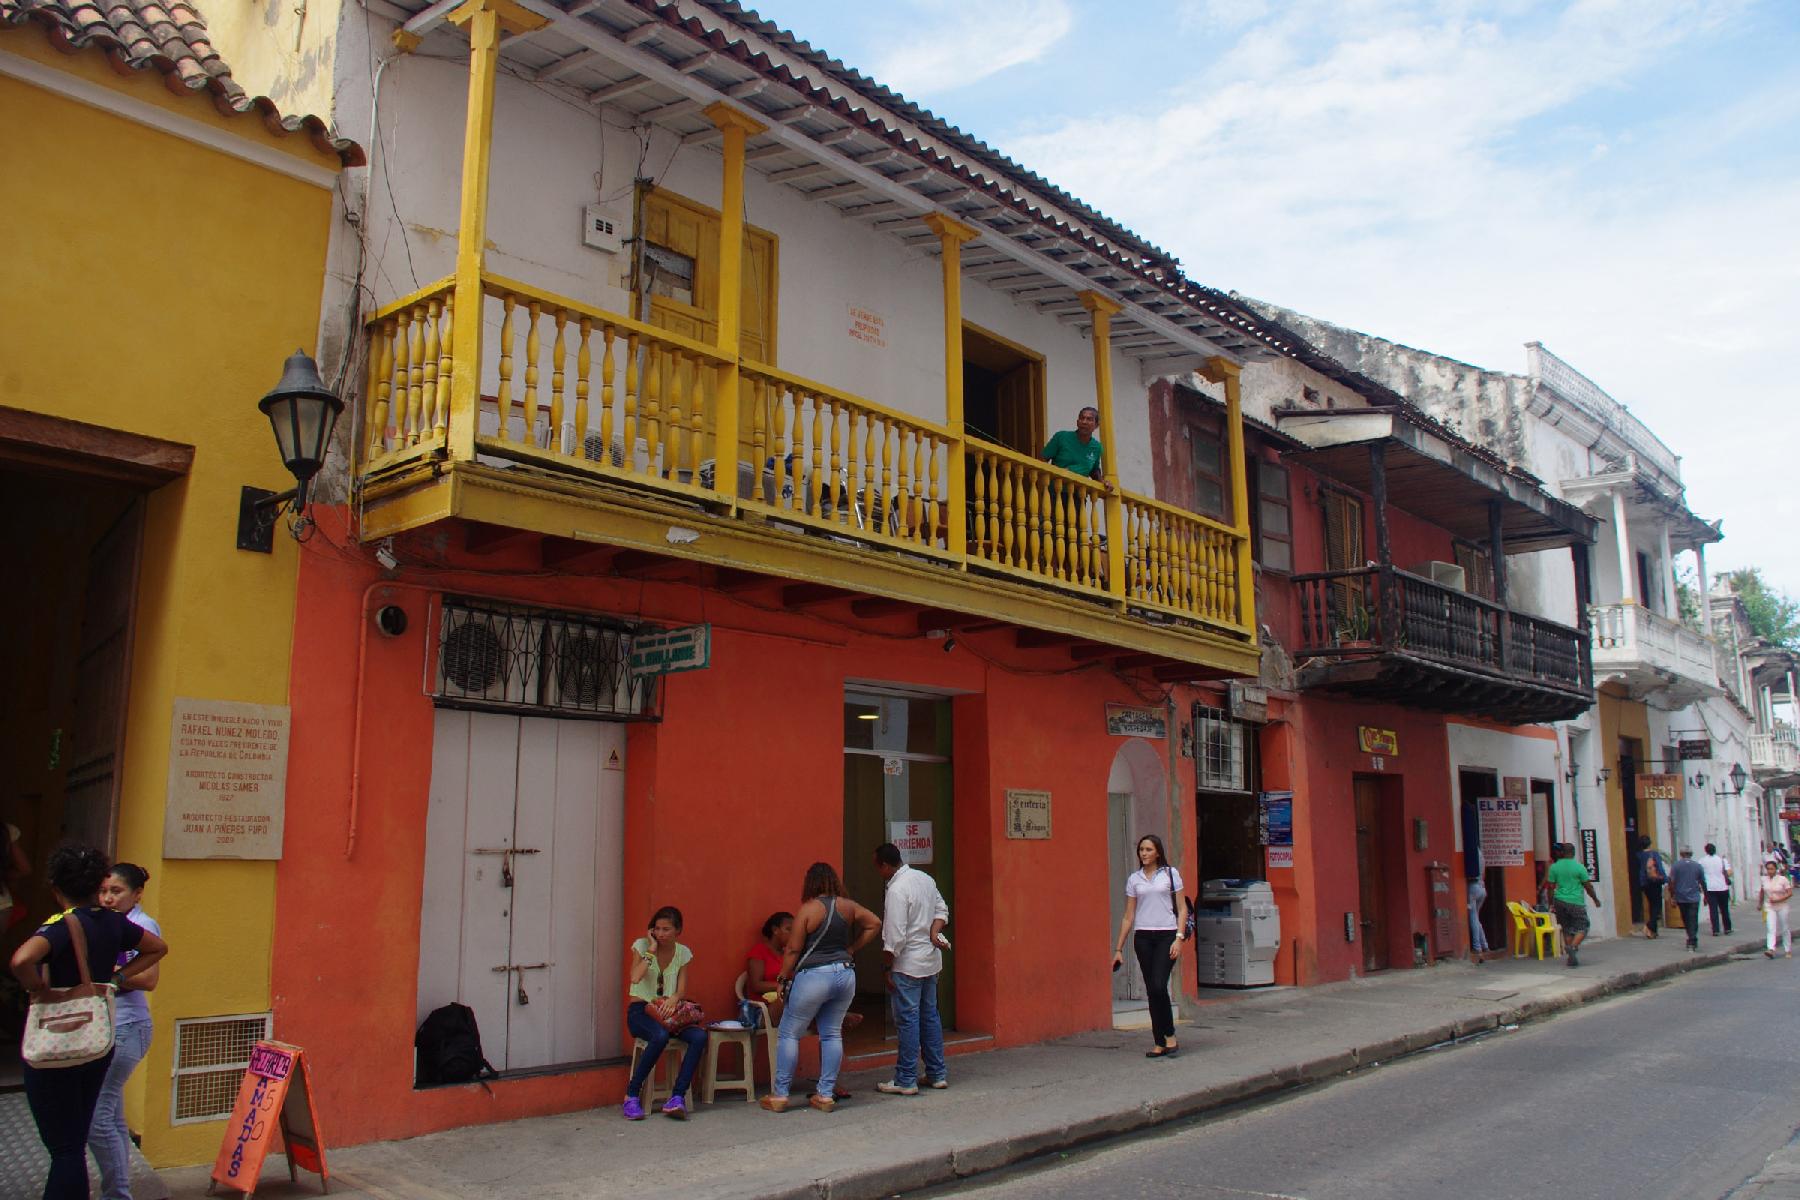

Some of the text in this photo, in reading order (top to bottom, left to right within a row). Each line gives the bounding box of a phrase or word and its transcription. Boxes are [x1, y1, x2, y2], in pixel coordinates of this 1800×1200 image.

[181, 724, 212, 736] RAFAEL
[199, 781, 230, 791] NICOLAS
[1644, 785, 1675, 800] 1533
[1480, 800, 1521, 811] EL REY
[183, 824, 204, 833] JUAN
[905, 824, 919, 836] SE
[893, 838, 932, 850] ARRIENDA
